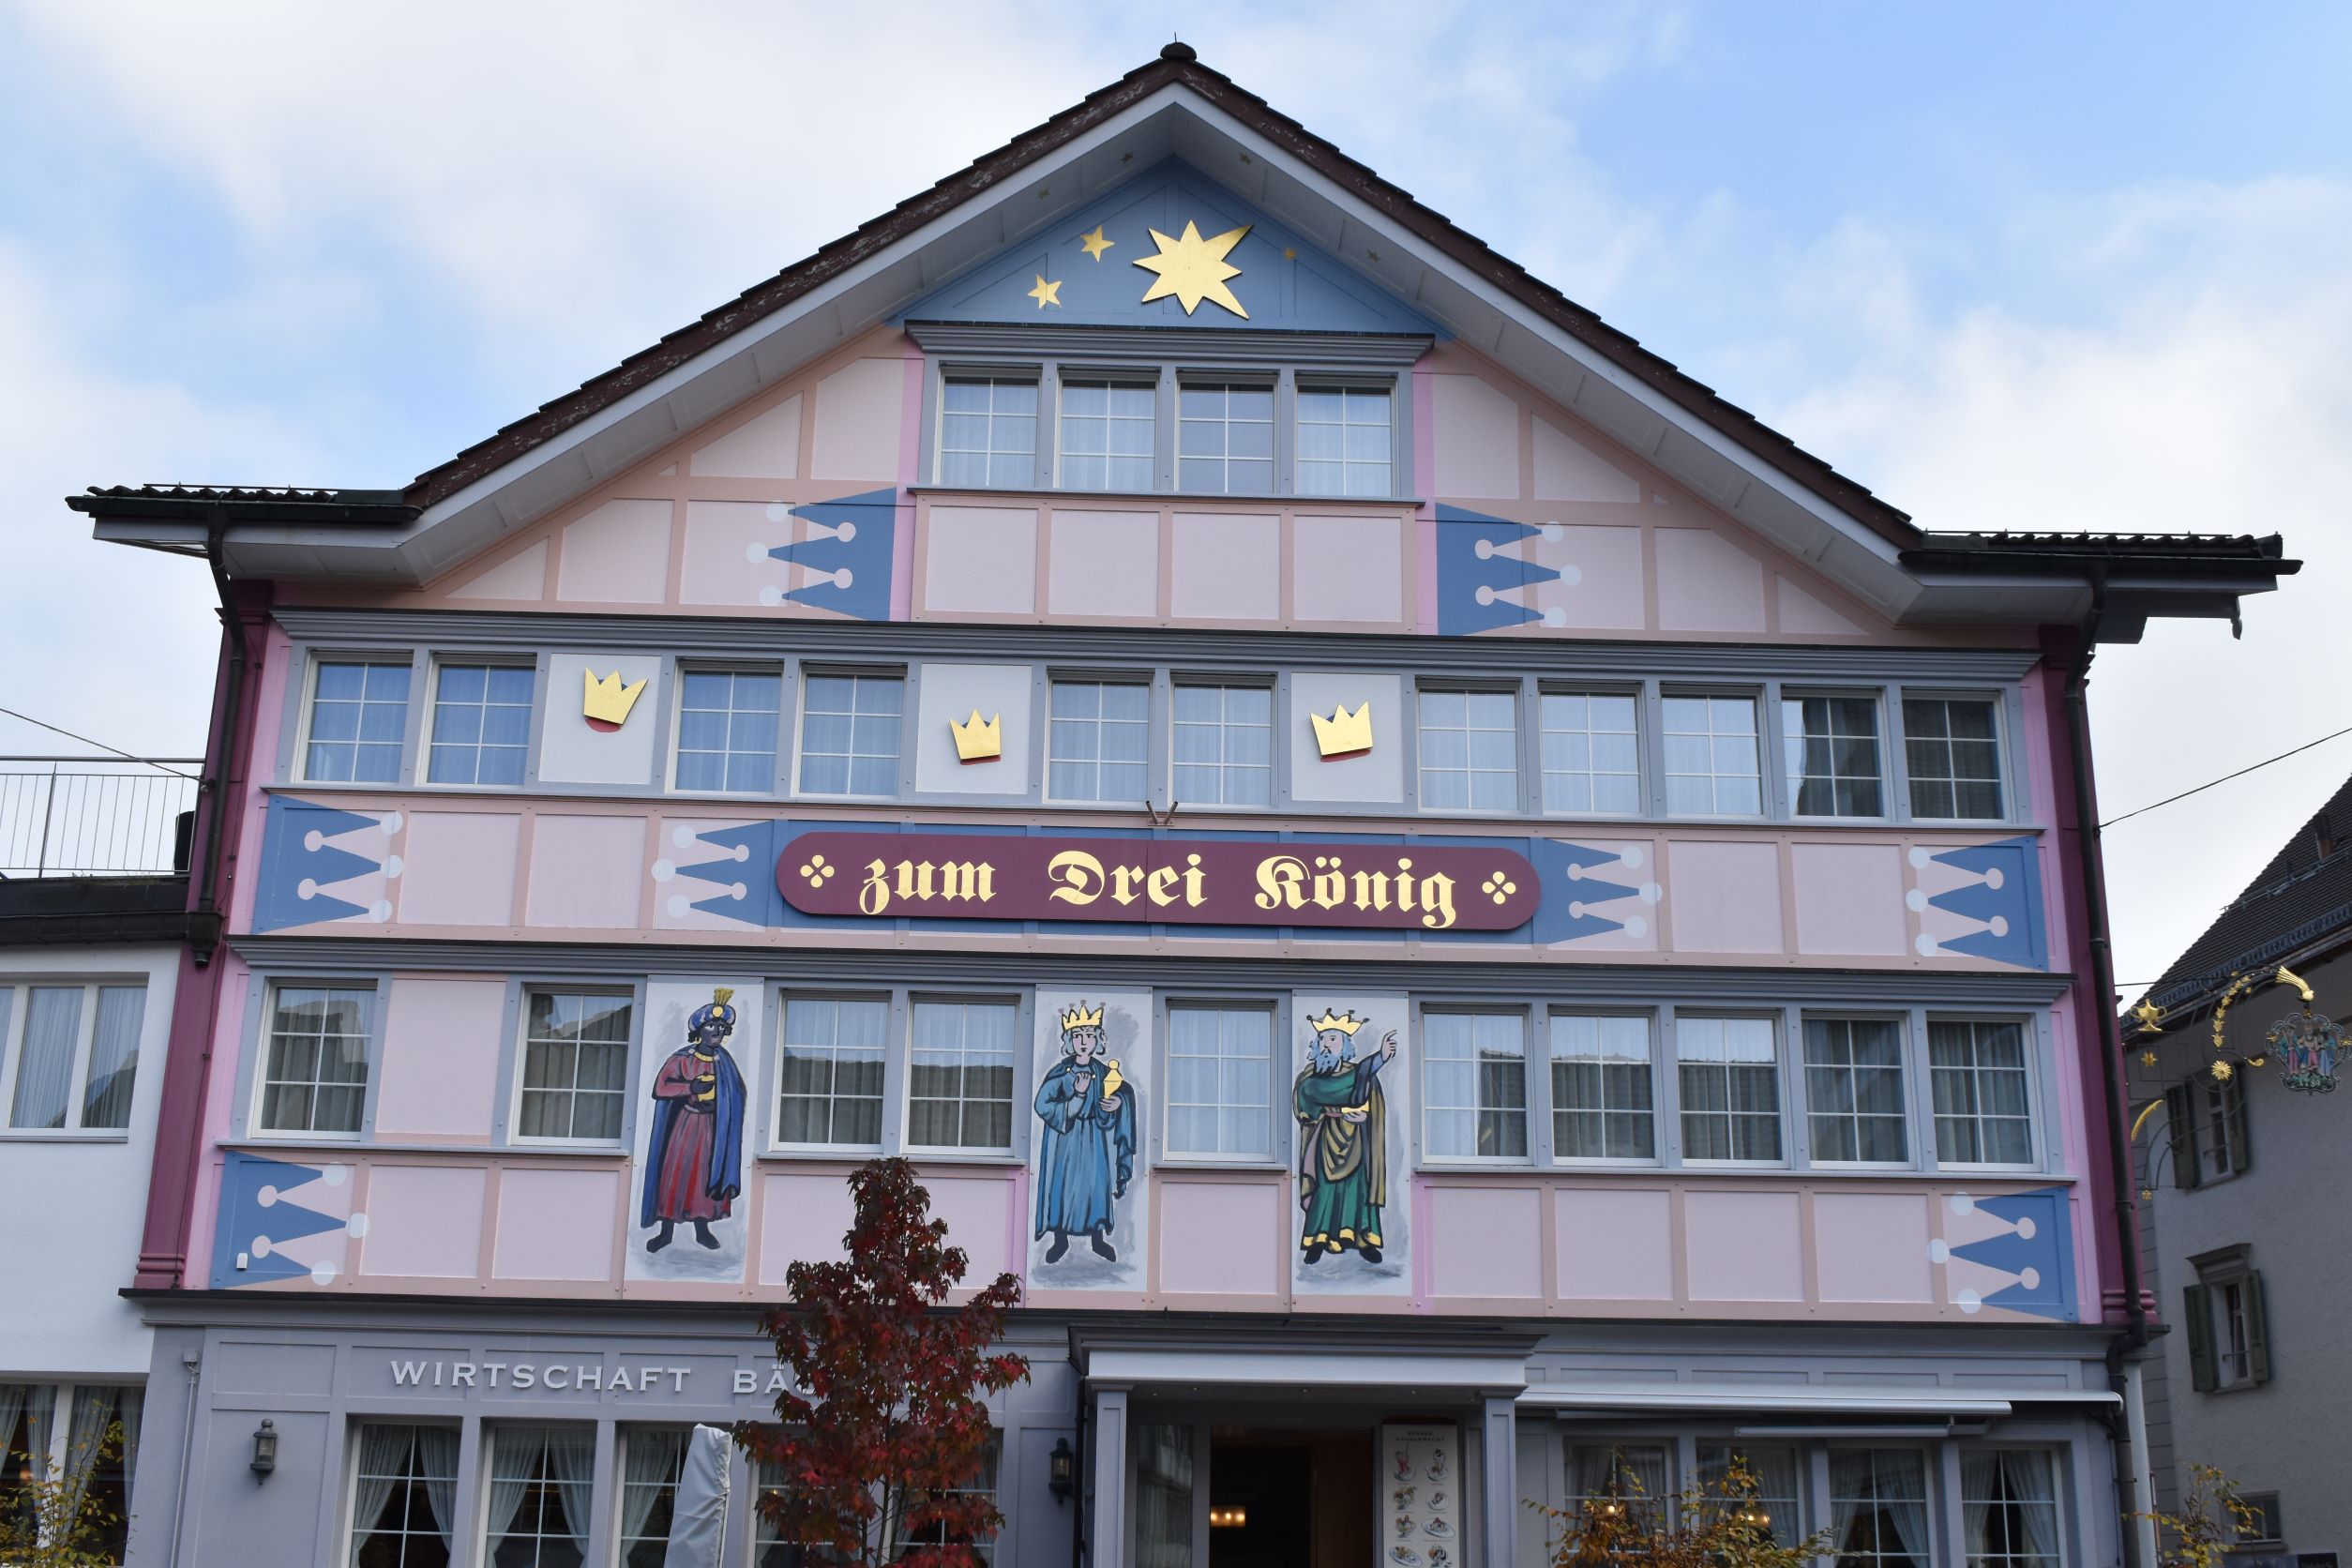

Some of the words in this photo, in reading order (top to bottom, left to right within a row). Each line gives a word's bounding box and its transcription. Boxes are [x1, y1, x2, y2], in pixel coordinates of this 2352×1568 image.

[859, 858, 996, 915] zum
[1048, 850, 1207, 908] Drei
[1255, 853, 1456, 929] König
[390, 1361, 691, 1392] WIRTSCHAFT
